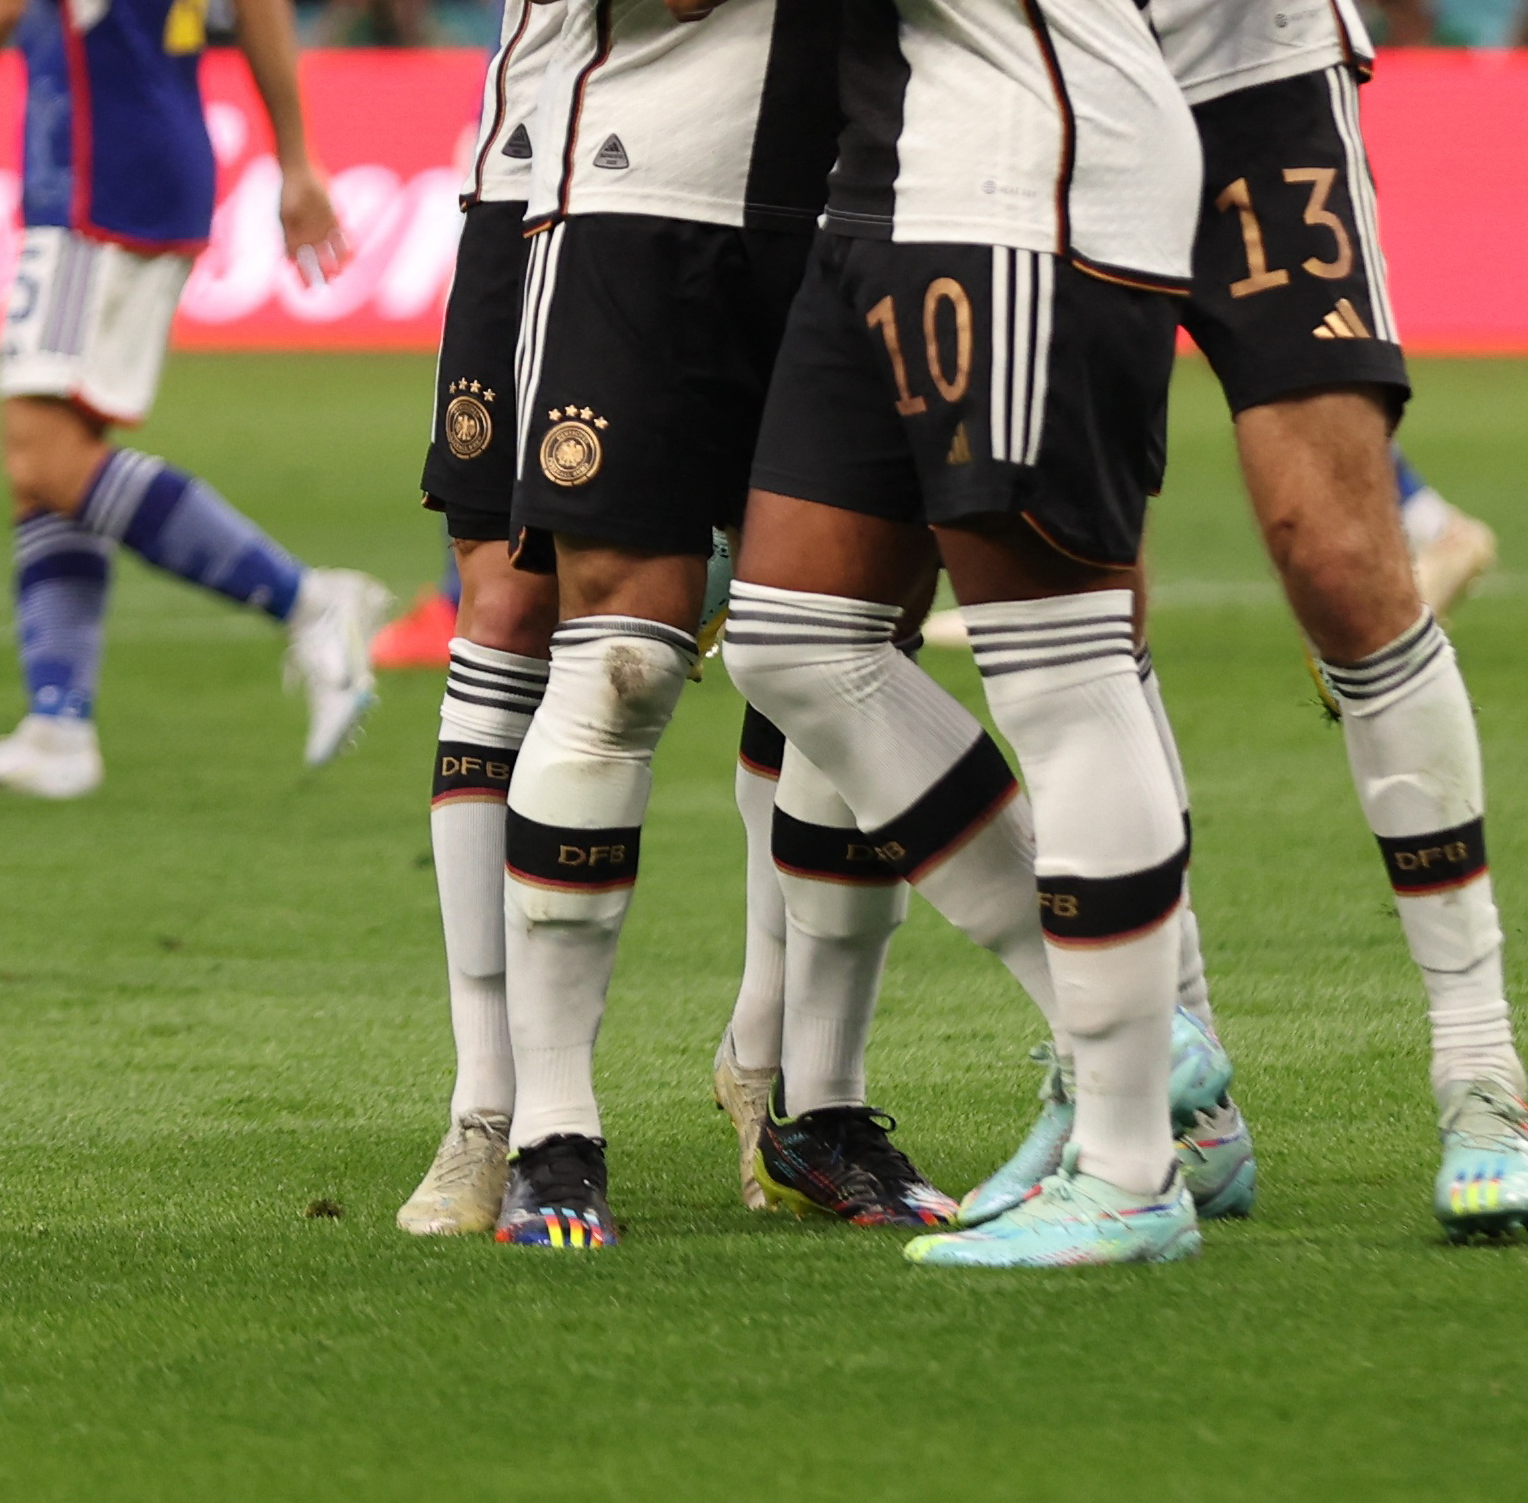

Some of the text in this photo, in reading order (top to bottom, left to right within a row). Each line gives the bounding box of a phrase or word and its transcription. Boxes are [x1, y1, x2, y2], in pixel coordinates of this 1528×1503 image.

[1215, 168, 1355, 297] 13
[866, 276, 973, 416] 10
[441, 756, 510, 779] DFB
[557, 844, 626, 866] DFB
[1393, 841, 1468, 870] DFB
[1039, 892, 1078, 917] FB
